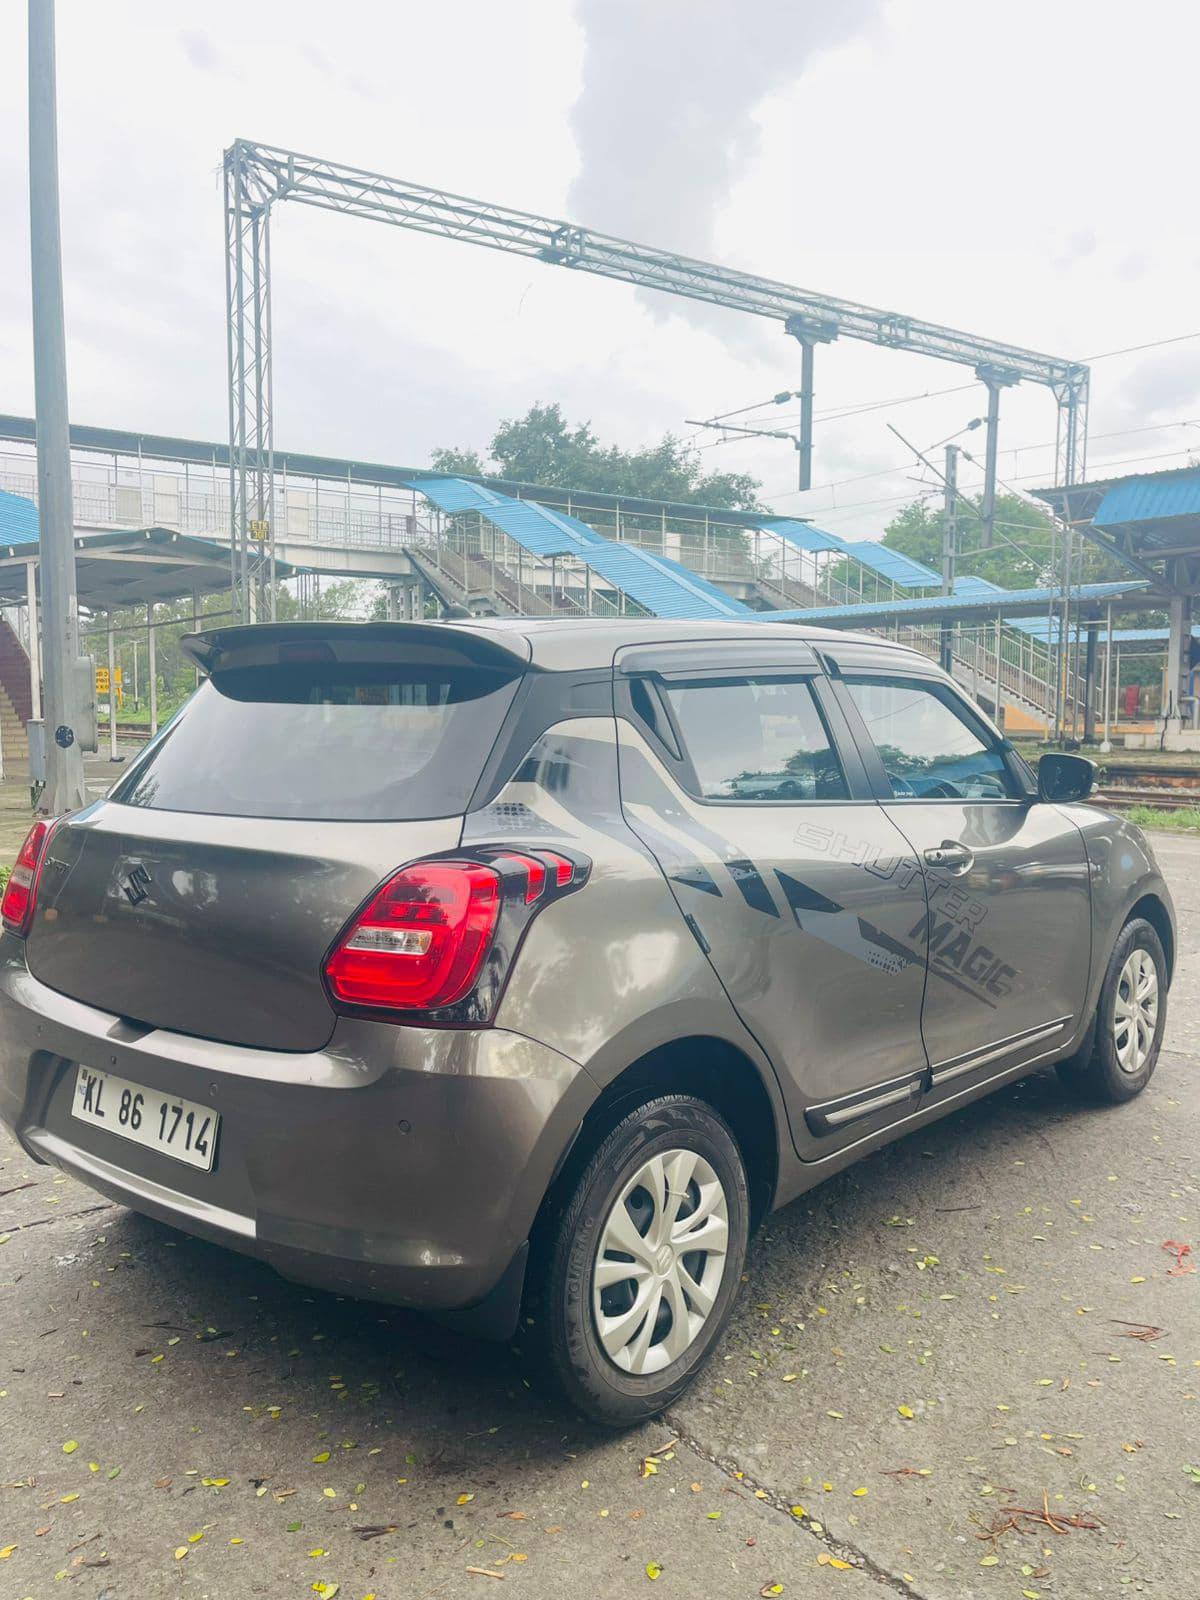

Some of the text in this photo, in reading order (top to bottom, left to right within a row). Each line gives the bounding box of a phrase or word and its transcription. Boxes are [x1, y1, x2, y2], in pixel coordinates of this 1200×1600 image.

[793, 822, 989, 932] SHUTTER
[908, 911, 1019, 997] MAGIC
[83, 1075, 211, 1157] KL 86 1714
